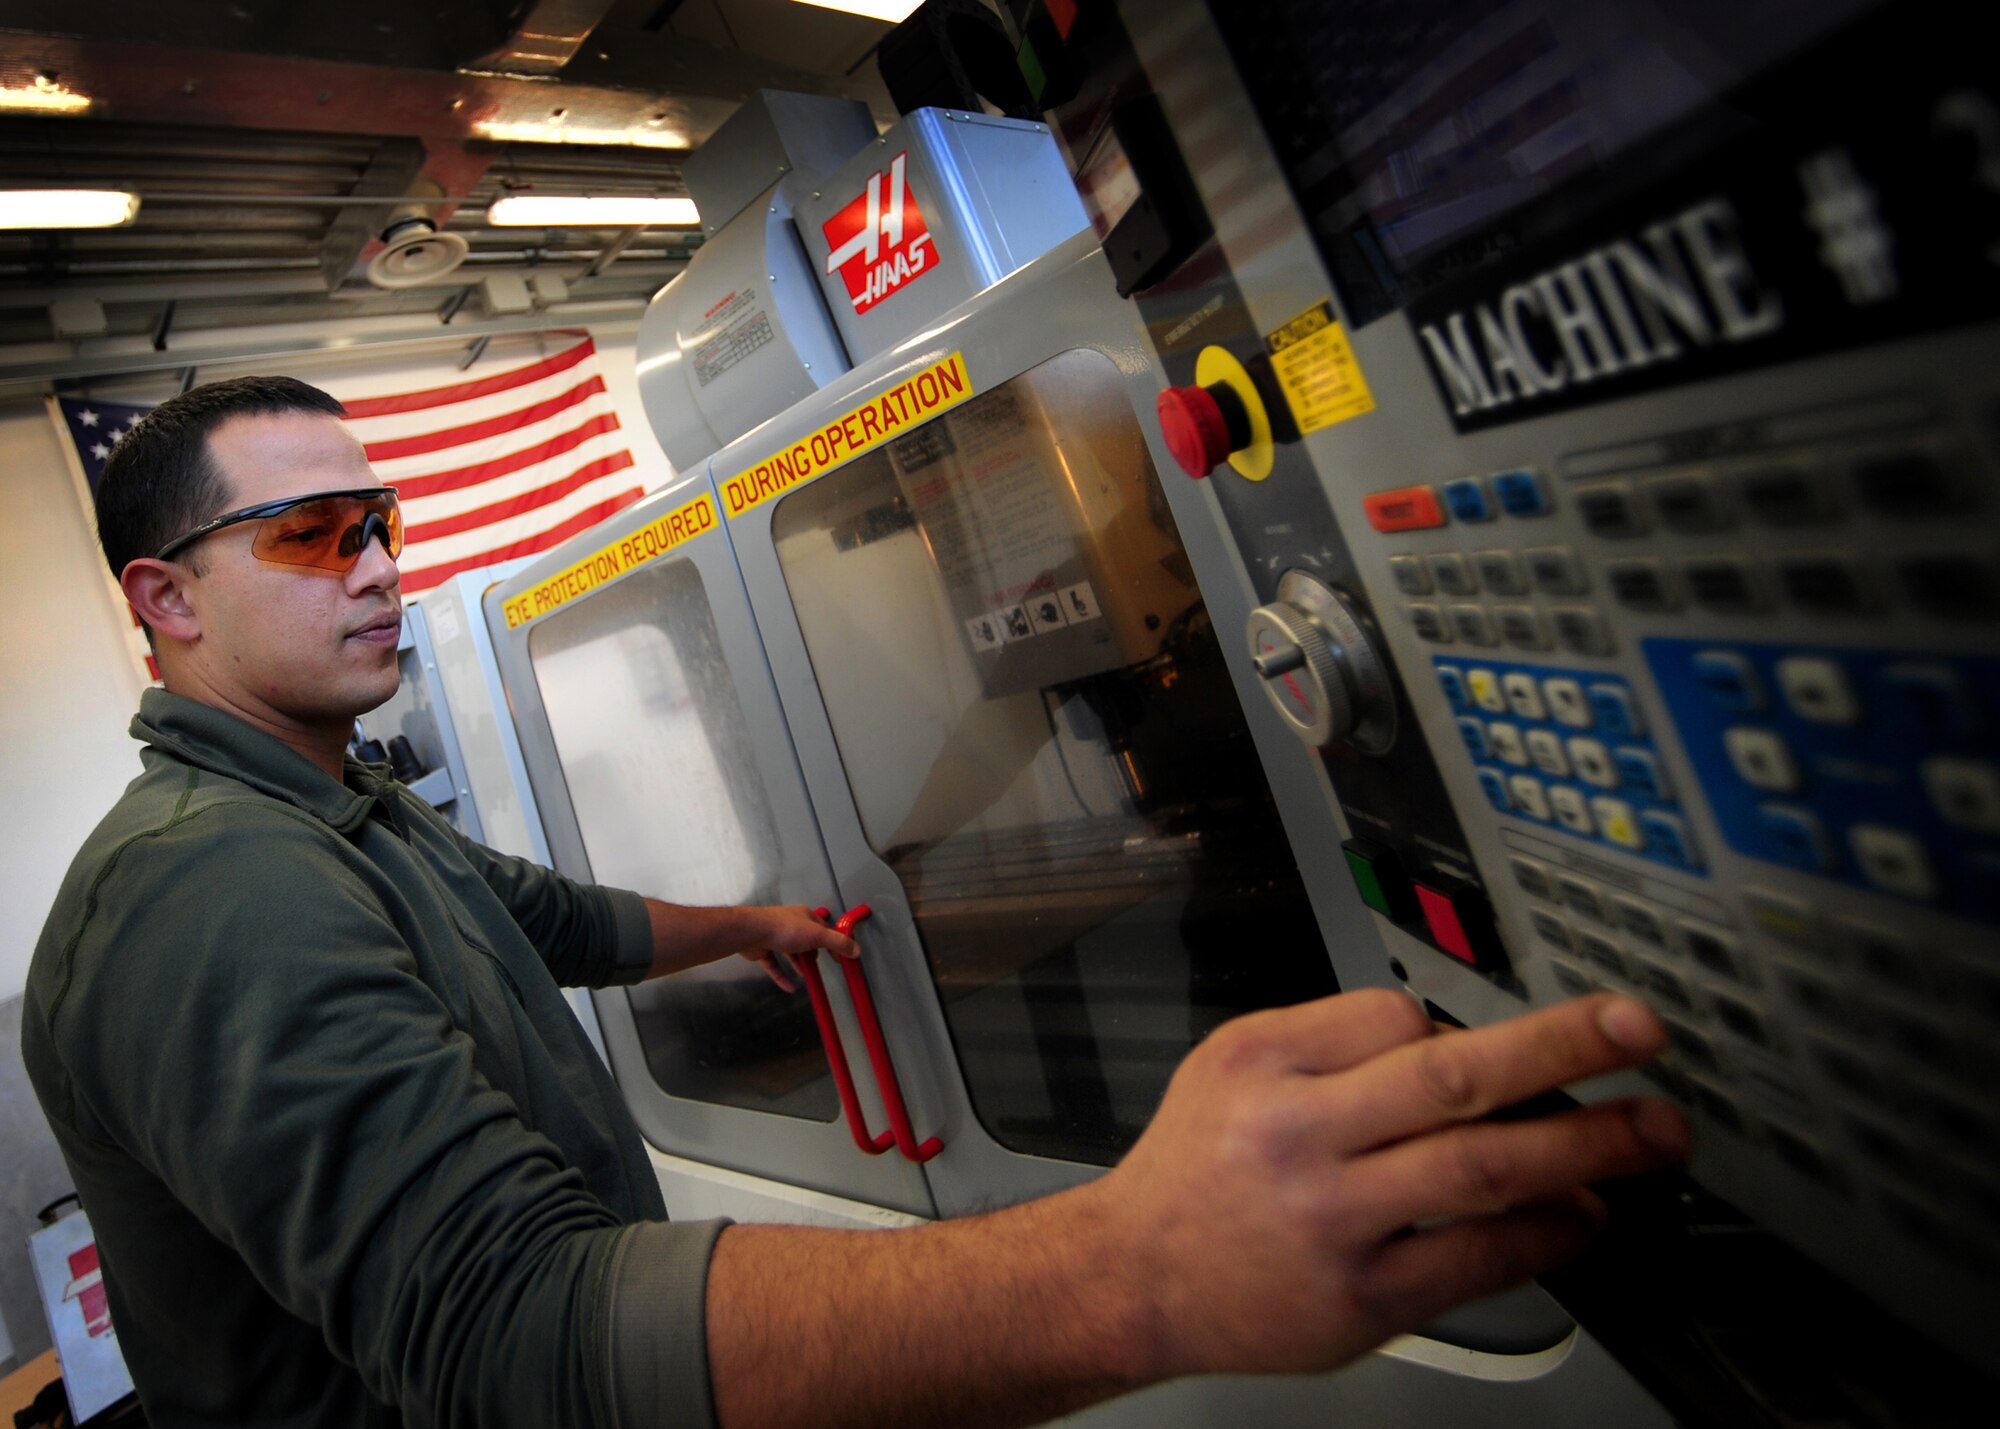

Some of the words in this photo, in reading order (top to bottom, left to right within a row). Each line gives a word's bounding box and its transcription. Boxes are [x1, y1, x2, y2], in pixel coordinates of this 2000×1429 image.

[852, 231, 931, 307] HAAS
[1421, 199, 1783, 415] MACHINE
[727, 445, 812, 512] DURING
[810, 358, 964, 467] OPERATION
[505, 598, 532, 628] EYE
[533, 548, 620, 615] PROTECTION
[620, 500, 712, 568] REQUIRED
